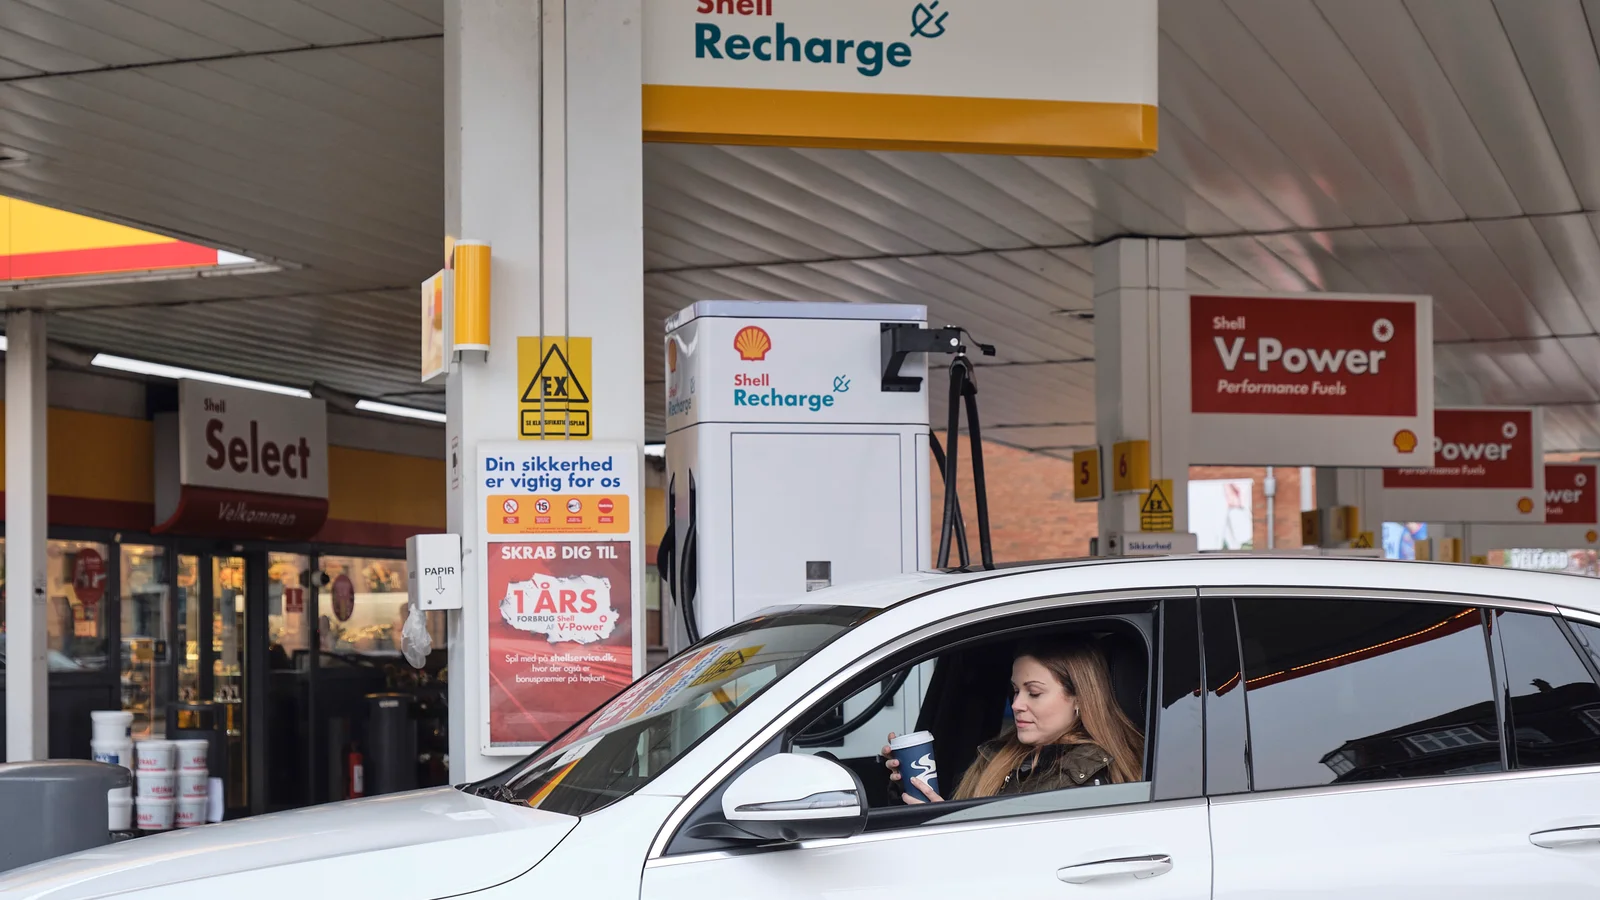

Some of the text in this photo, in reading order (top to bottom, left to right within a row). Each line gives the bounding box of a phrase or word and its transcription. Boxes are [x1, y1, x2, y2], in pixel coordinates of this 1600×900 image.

[697, 0, 772, 16] Shell
[695, 22, 912, 77] Recharge
[1213, 316, 1245, 330] Shell
[1213, 336, 1386, 375] V-Power
[543, 376, 568, 396] EX
[734, 374, 769, 387] Shell
[1217, 379, 1347, 396] Performance Fuels
[203, 398, 226, 414] Shell
[734, 388, 834, 412] Recharge
[206, 419, 310, 479] Select
[486, 456, 613, 472] Din sikkerhed
[1119, 453, 1128, 478] 6
[1462, 465, 1486, 475] Fuels
[1080, 461, 1090, 485] 5
[485, 473, 620, 492] er vigtig for os
[537, 502, 548, 511] 15
[1150, 500, 1163, 510] EX
[218, 501, 297, 526] Velkommen
[501, 545, 618, 560] SKRAB DIG TIL
[424, 566, 455, 576] PAPIR
[513, 581, 598, 614] 1 ÅRS
[558, 622, 604, 631] V-Power
[505, 653, 617, 664] Spil med på shellservice.dk,
[532, 664, 548, 672] hvor
[550, 664, 562, 672] der
[563, 664, 581, 674] også
[516, 674, 566, 684] bonuspræmier
[568, 673, 578, 684] på
